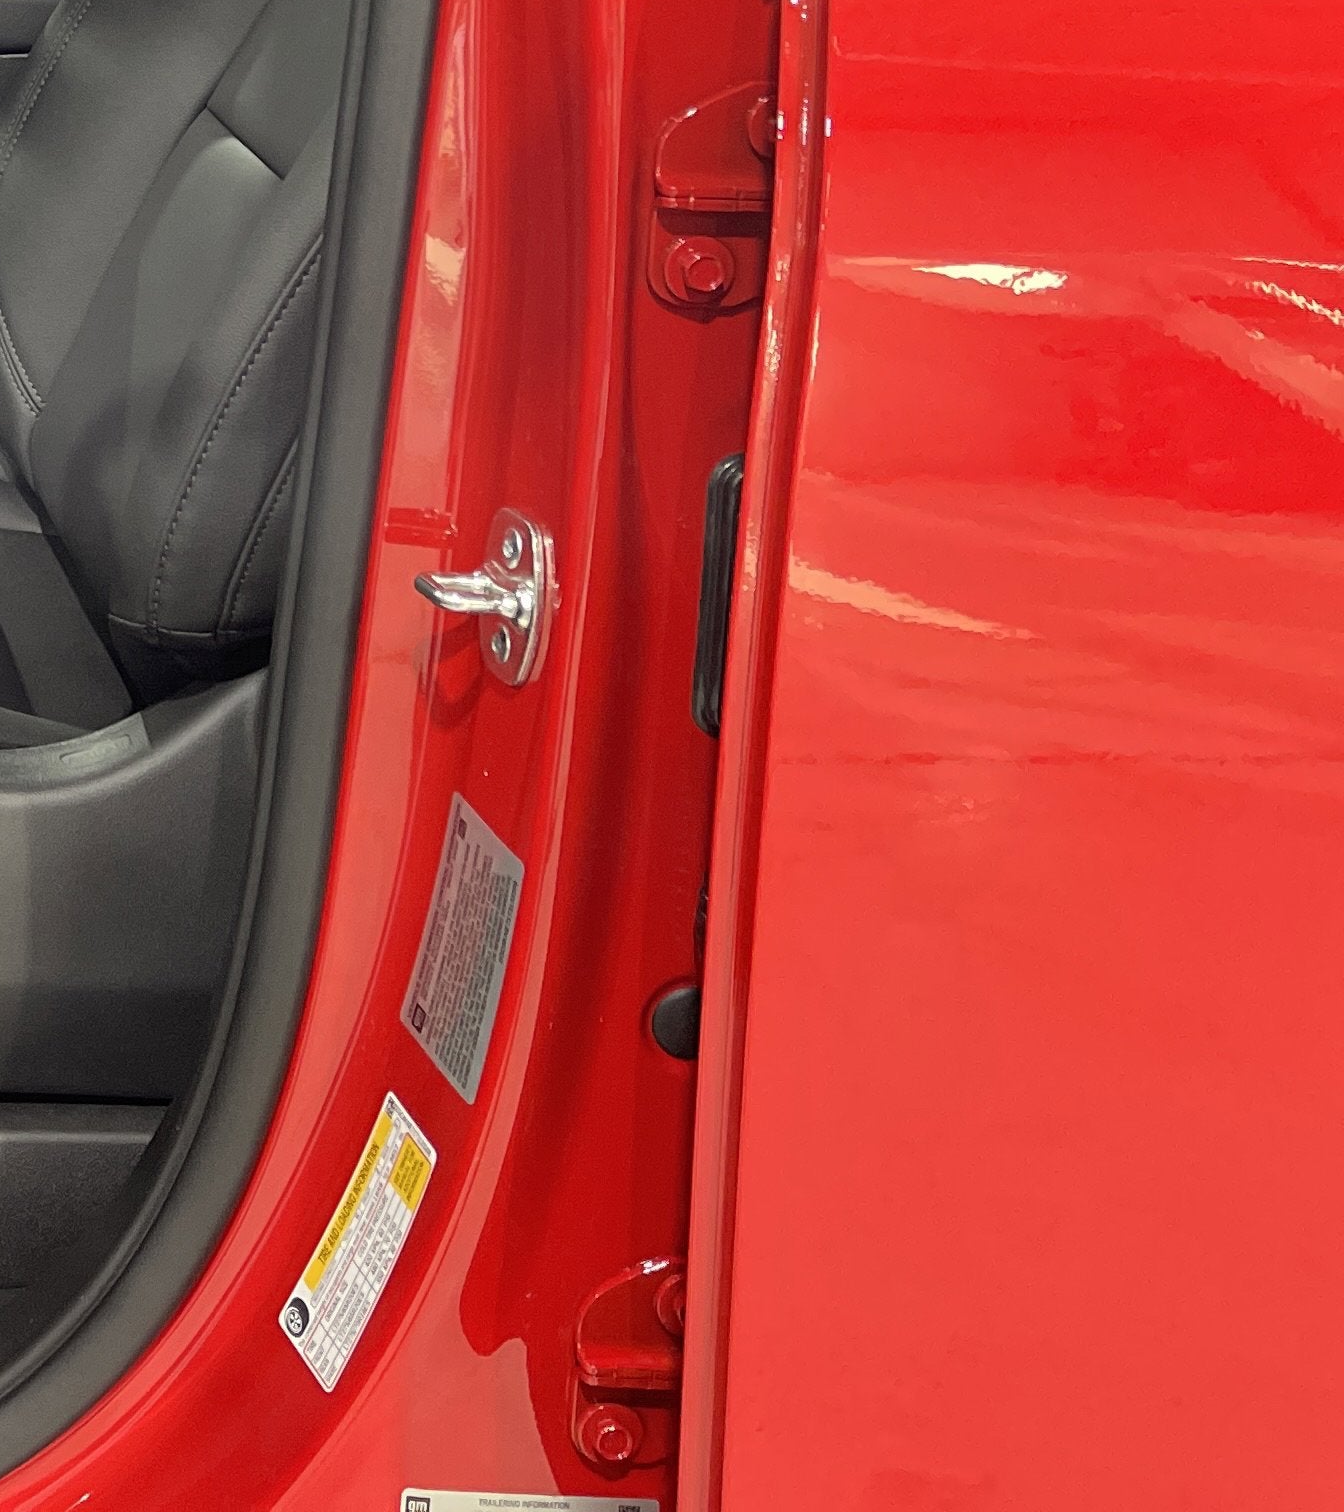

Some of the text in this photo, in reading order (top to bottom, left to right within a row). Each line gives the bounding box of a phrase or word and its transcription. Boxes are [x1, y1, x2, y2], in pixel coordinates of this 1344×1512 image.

[326, 1224, 340, 1249] AND
[334, 1190, 357, 1232] LOADING
[350, 1139, 380, 1196] INFORMATION
